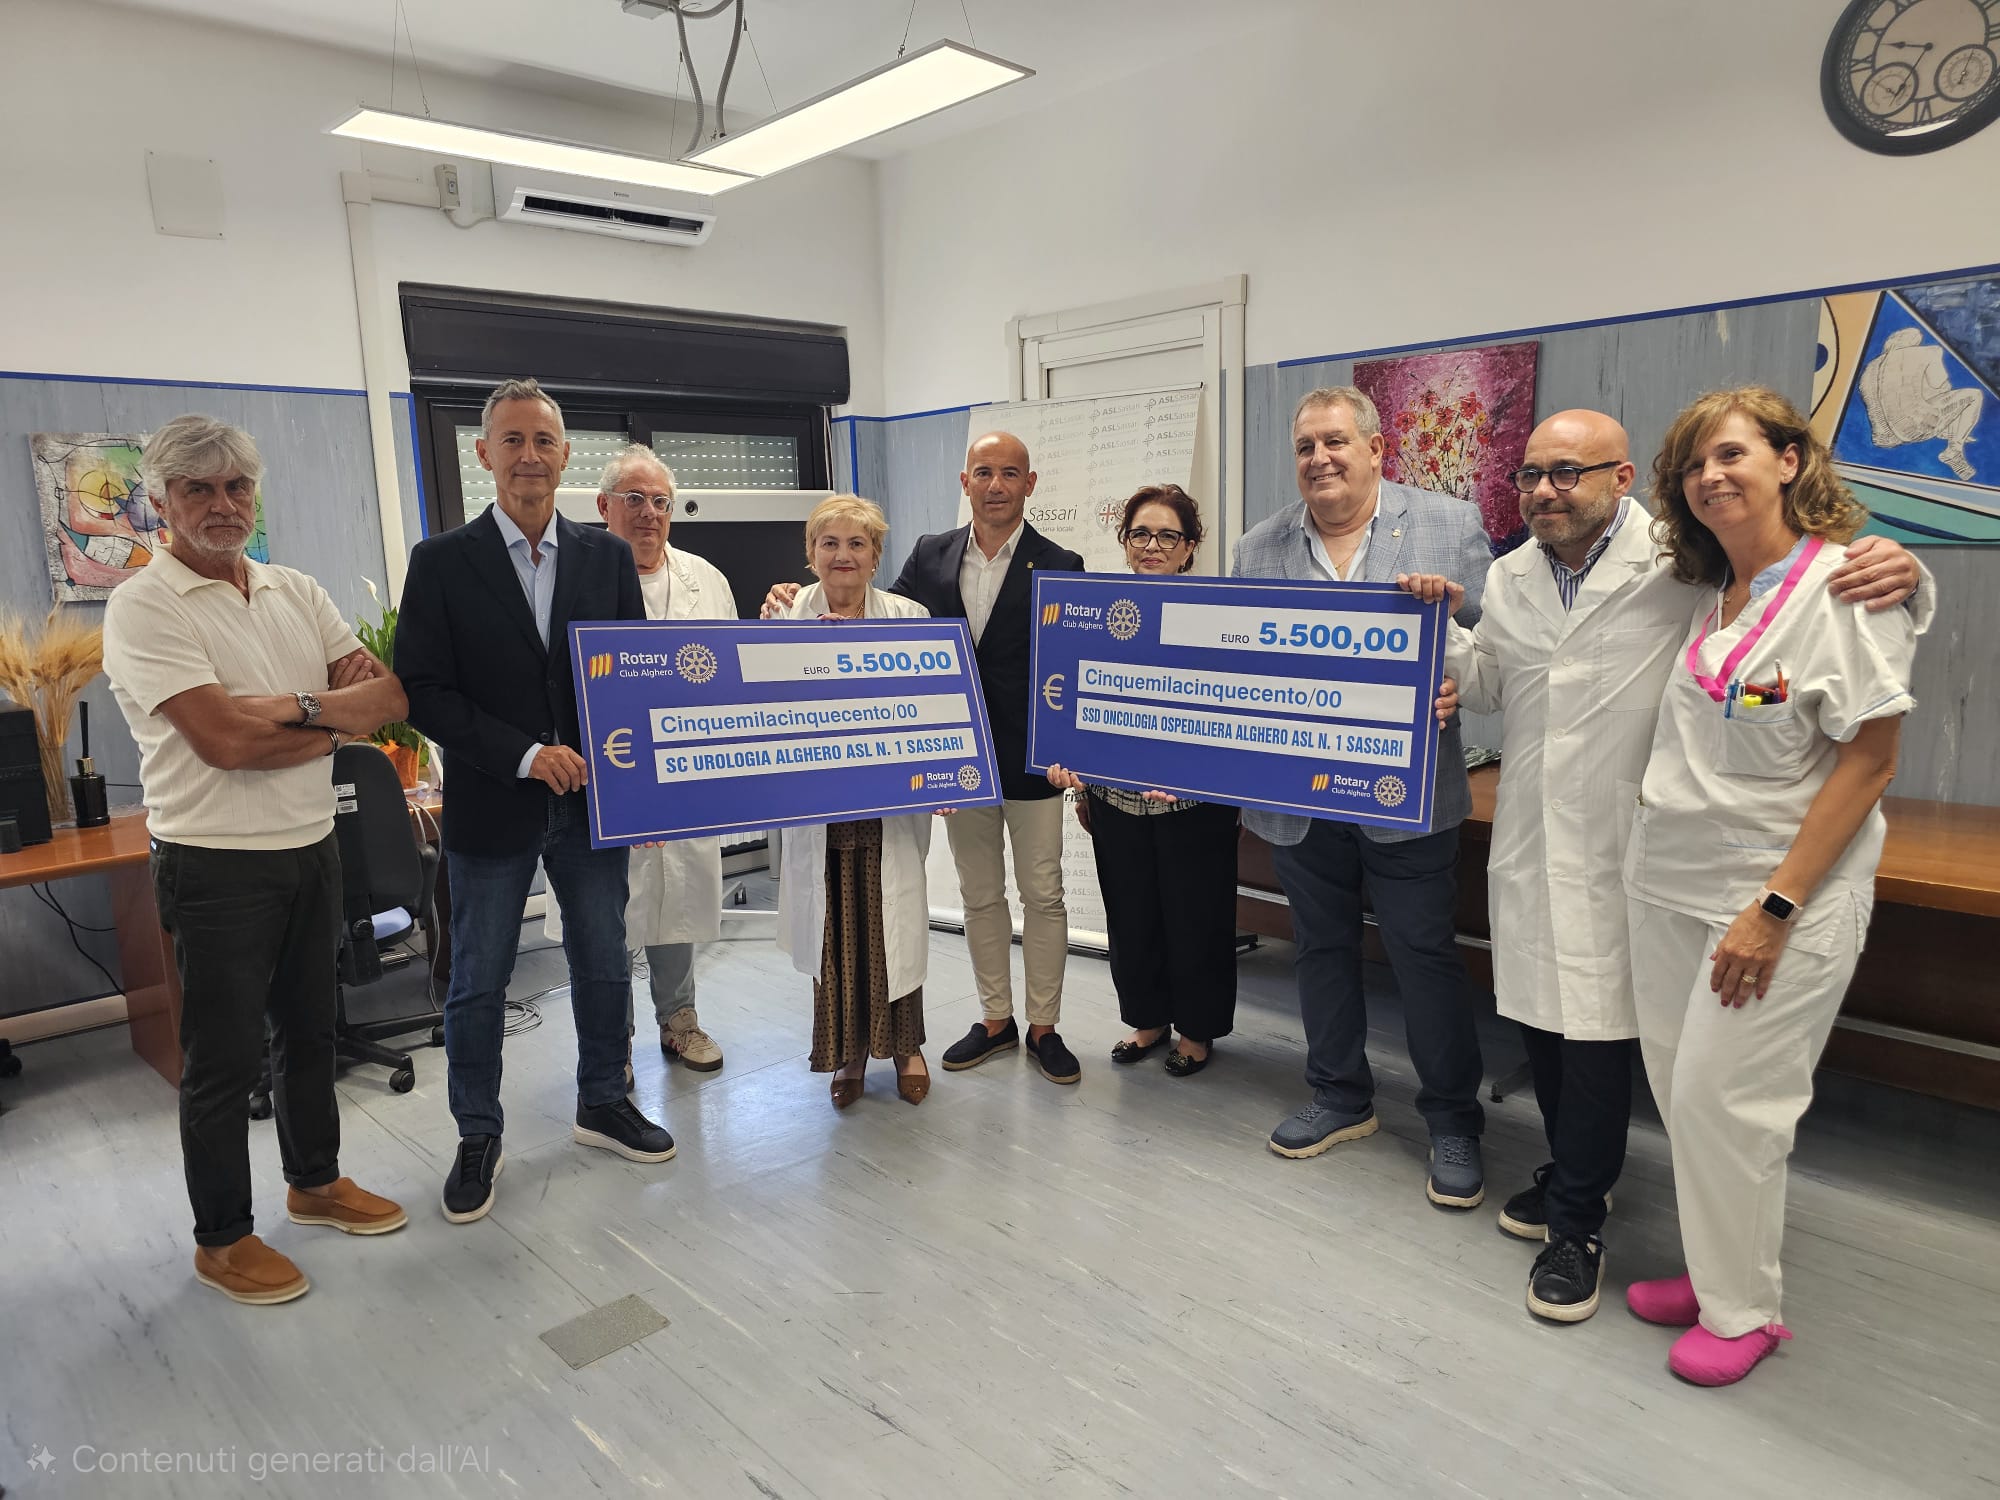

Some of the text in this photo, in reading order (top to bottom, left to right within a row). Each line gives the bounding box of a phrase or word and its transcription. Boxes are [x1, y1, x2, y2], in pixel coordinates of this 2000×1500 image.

[1029, 504, 1078, 522] Sassari
[1064, 603, 1102, 620] Rotary
[1062, 620, 1077, 628] Club
[1078, 621, 1103, 631] Alghero
[1221, 621, 1409, 656] EURO 5.500,00
[619, 651, 668, 667] Rotary
[803, 650, 952, 675] EURO 5.500,00
[619, 668, 639, 678] Club
[640, 668, 673, 679] Alghero
[1085, 668, 1342, 709] Cinquemilacinquecento/00
[660, 703, 918, 735] Cinquemilacinquecento/00
[1082, 706, 1404, 757] SSD ONCOLOGIA OSPEDALIERA ALGHERO ASL N. 1 SASSARI
[665, 736, 964, 773] SC UROLOGIA ALGHERO ASL N. 1 SASSARI
[926, 772, 954, 781] Rotary
[1334, 774, 1370, 790] Rotary
[1331, 787, 1371, 798] Club Alghero
